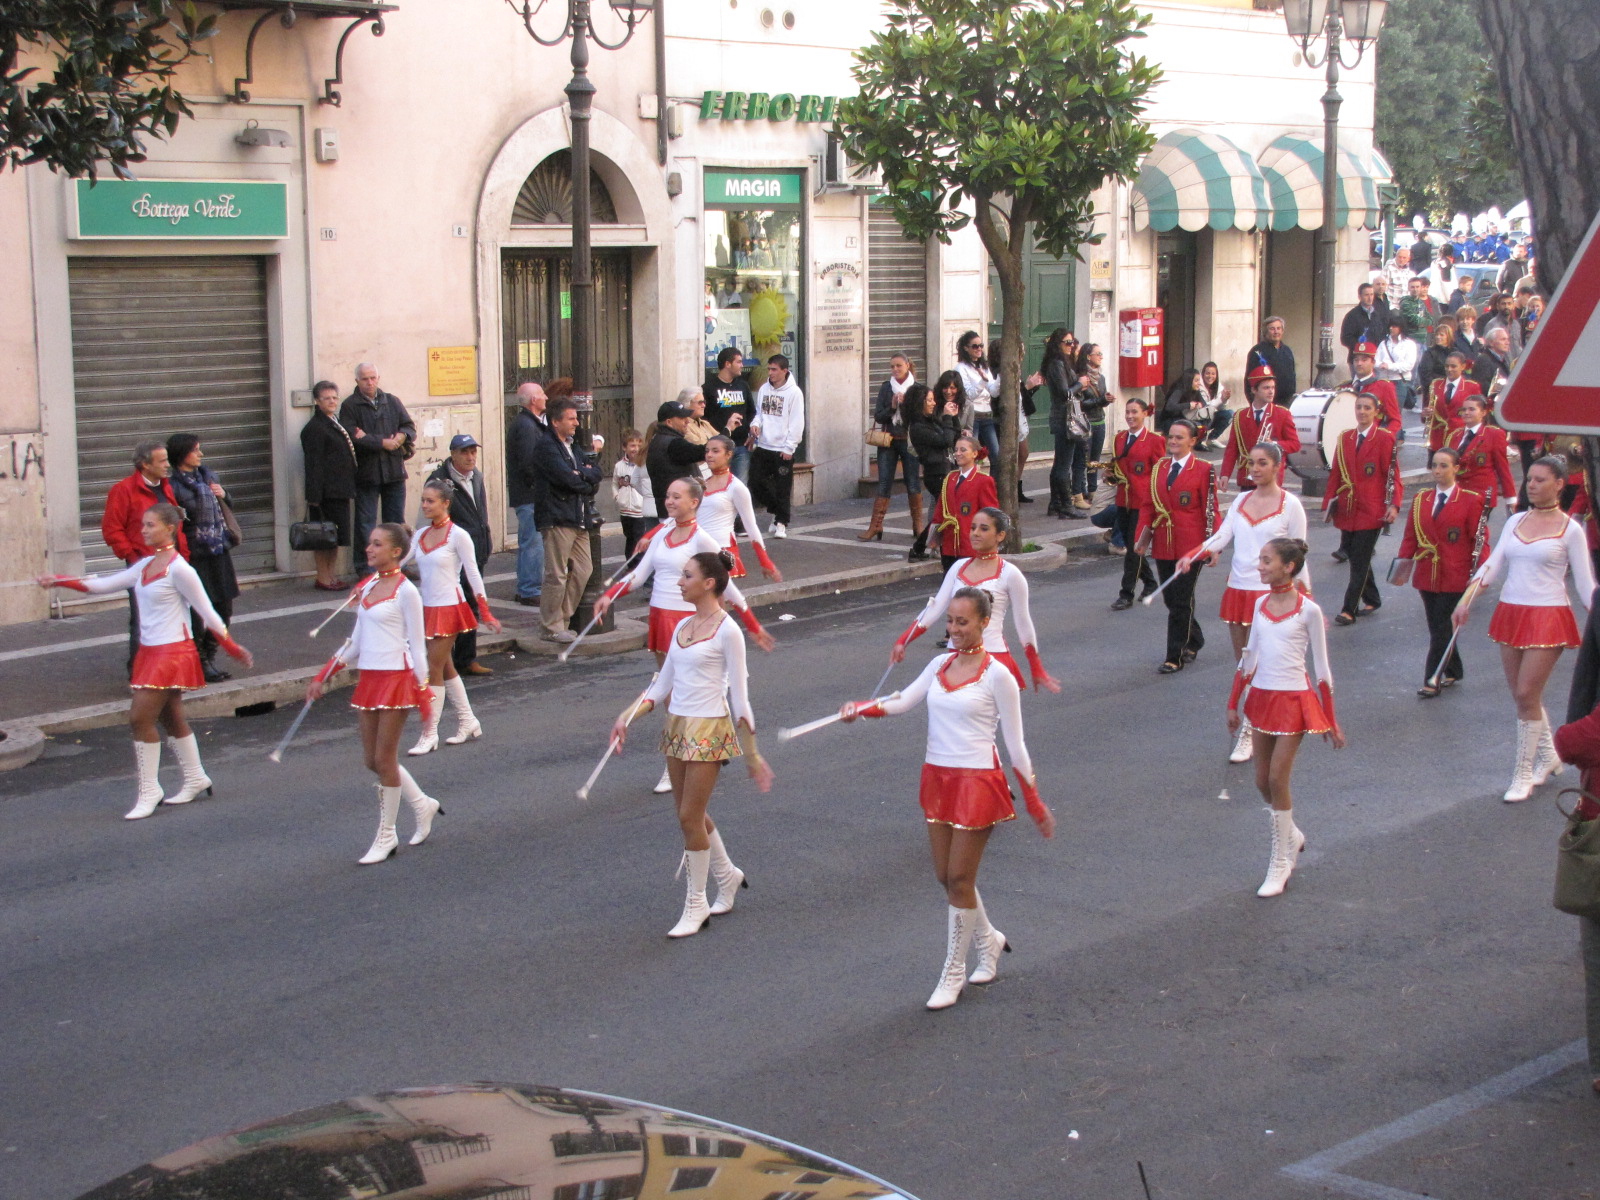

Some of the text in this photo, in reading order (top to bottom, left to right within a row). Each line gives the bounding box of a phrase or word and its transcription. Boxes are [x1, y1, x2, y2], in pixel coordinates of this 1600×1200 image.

[725, 179, 781, 197] MAGIA
[132, 193, 241, 225] Bottega Verde
[325, 229, 334, 239] 10
[457, 226, 462, 236] 8
[820, 262, 859, 280] ERBORISTERIA
